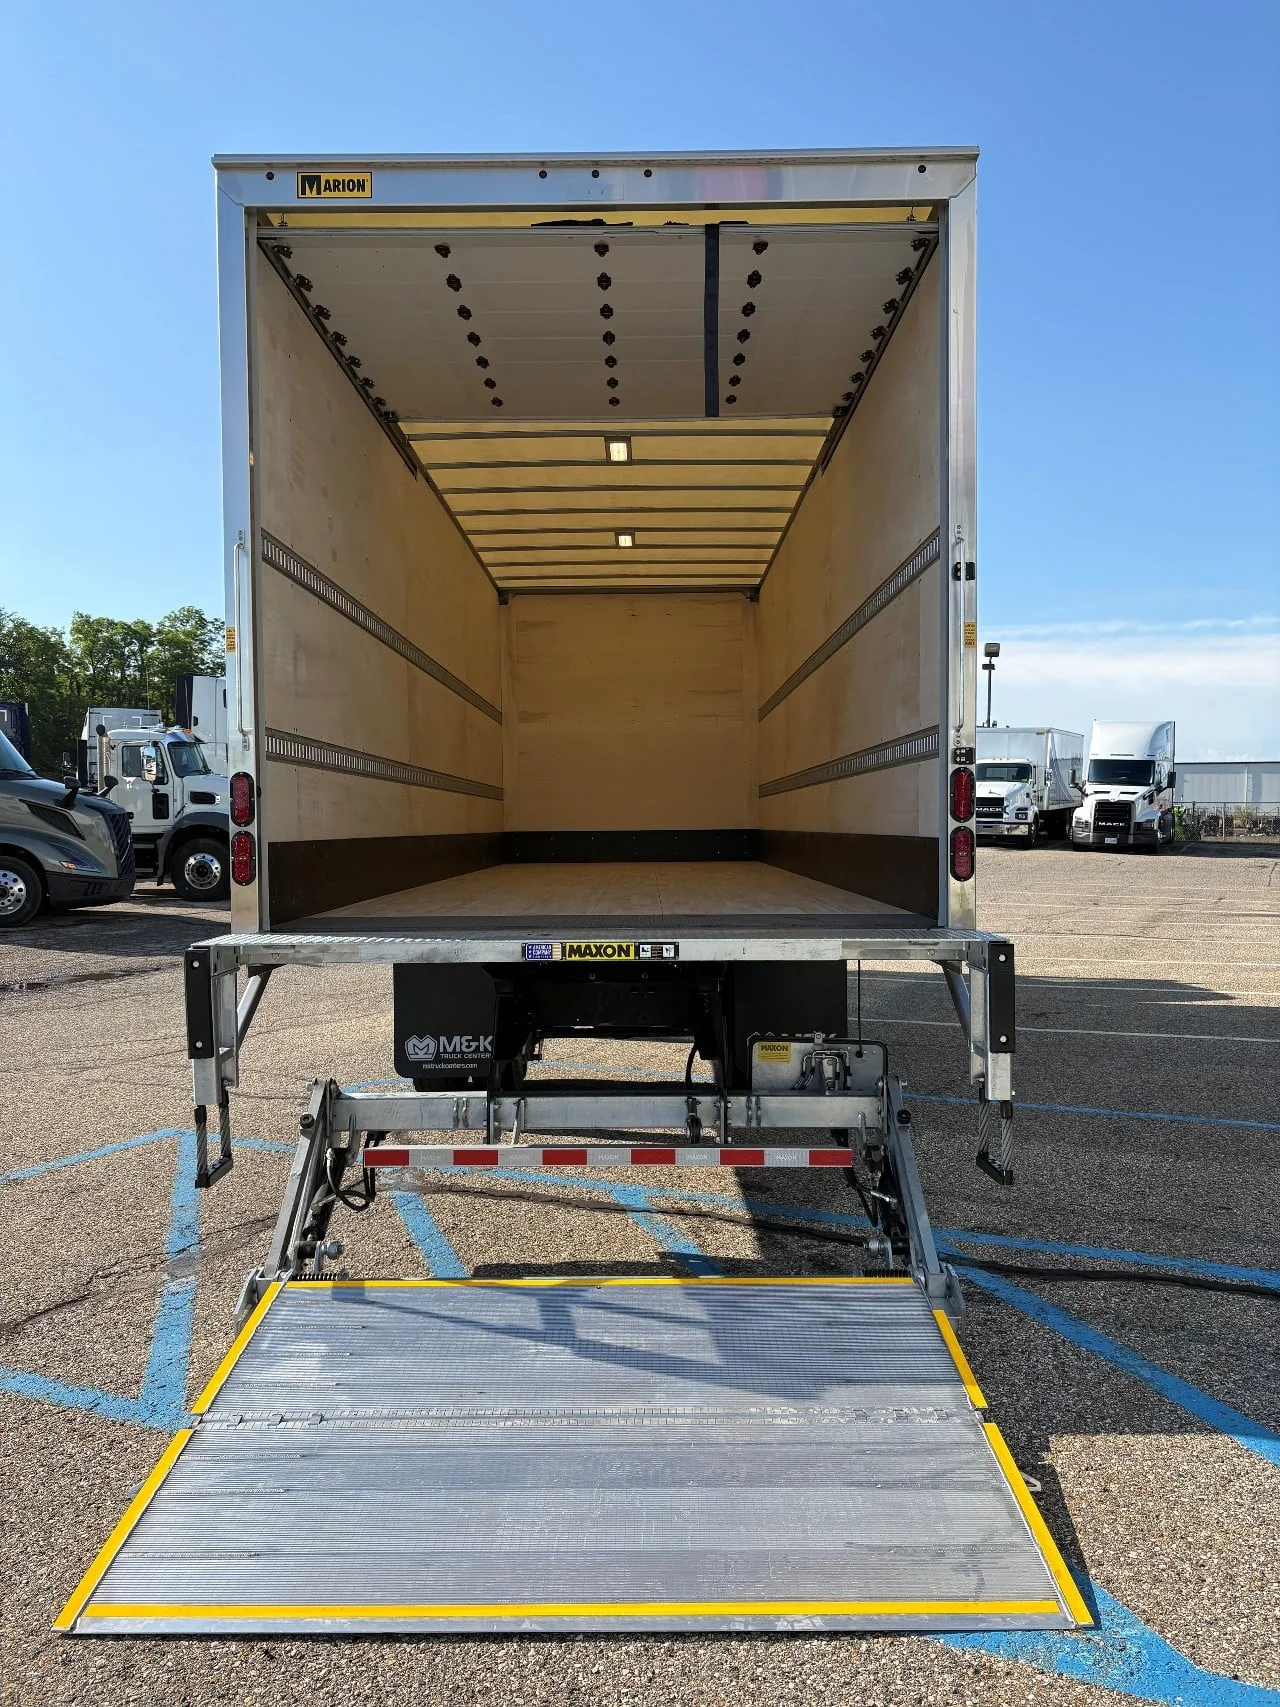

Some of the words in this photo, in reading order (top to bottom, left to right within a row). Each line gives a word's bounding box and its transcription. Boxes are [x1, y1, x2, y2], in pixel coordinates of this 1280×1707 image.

[300, 174, 366, 196] MARION
[567, 943, 631, 958] MAXON
[439, 1035, 493, 1053] M&K
[760, 1044, 789, 1052] MAXON
